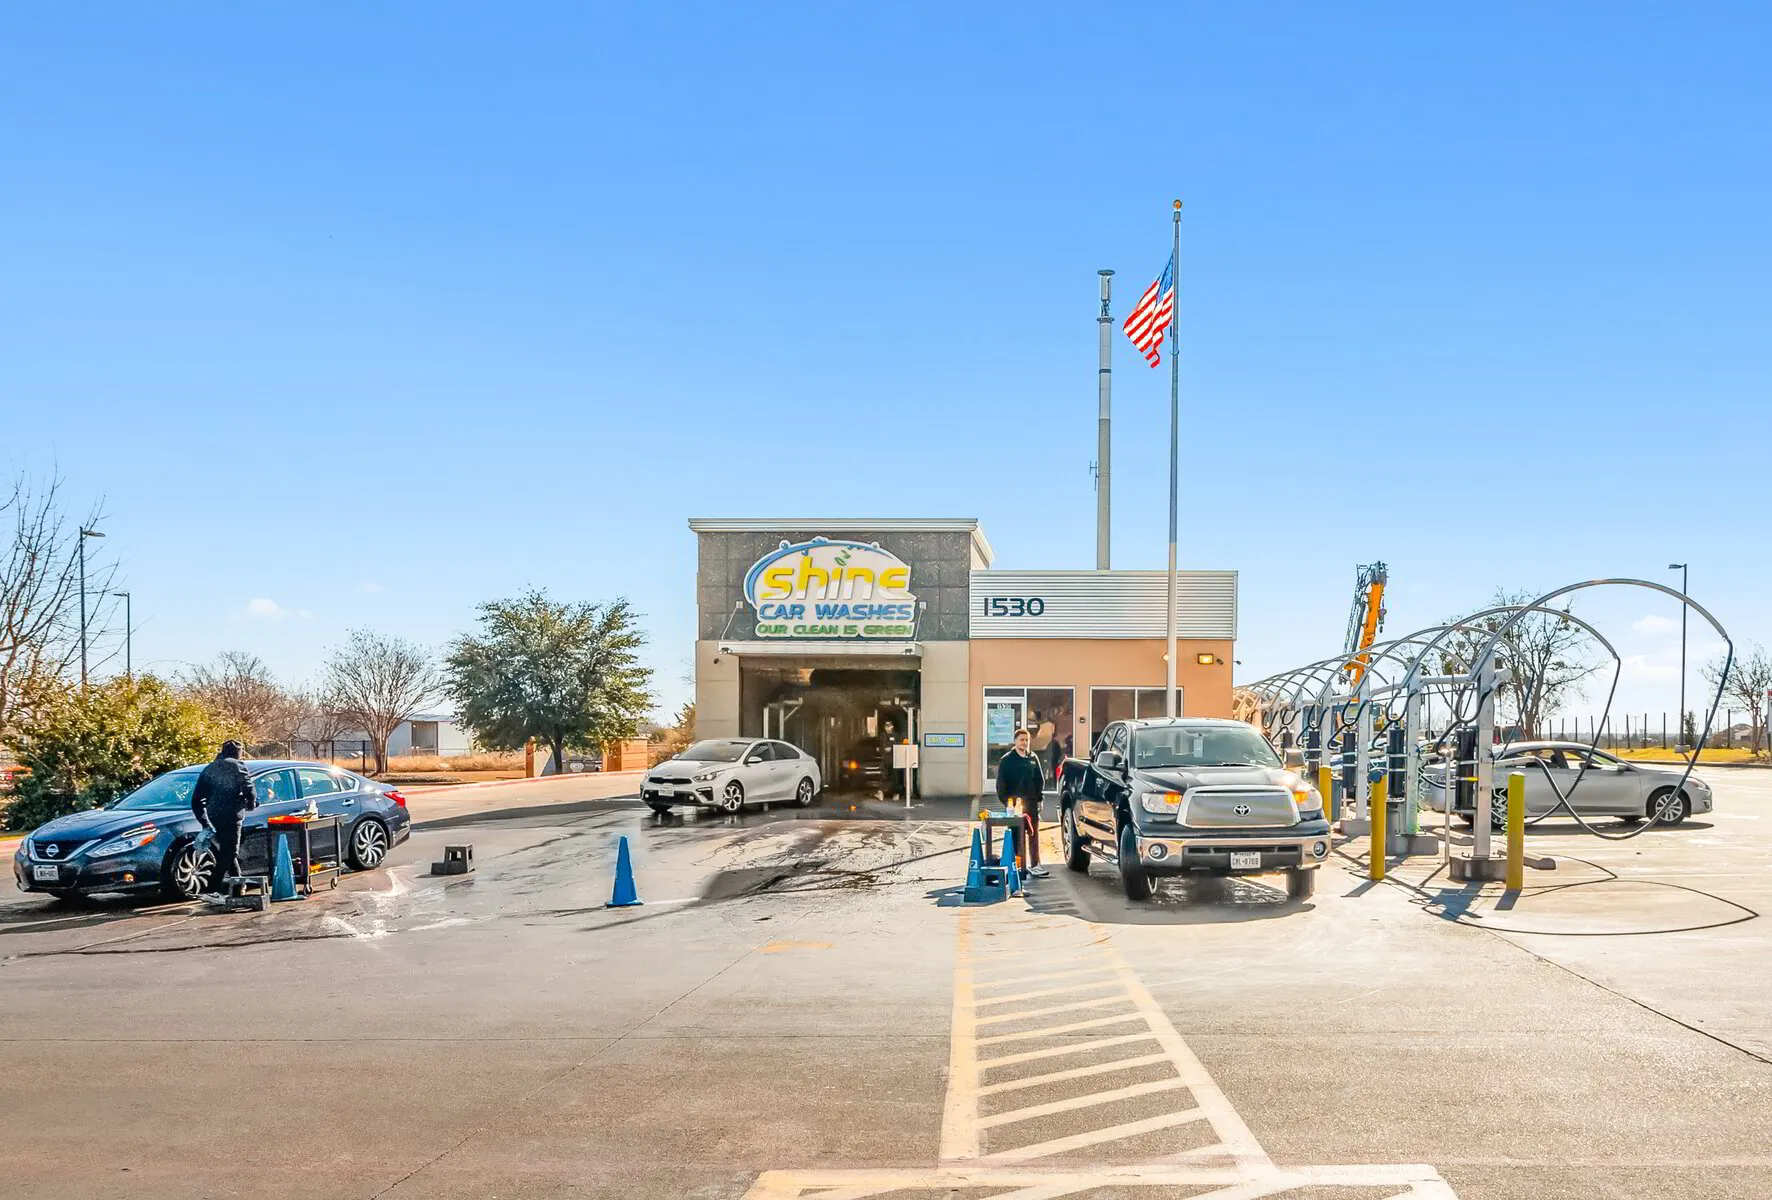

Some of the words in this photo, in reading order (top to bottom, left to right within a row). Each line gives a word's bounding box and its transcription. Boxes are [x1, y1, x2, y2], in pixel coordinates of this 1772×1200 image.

[760, 556, 912, 600] shine
[759, 603, 804, 620] CAR
[815, 603, 912, 620] WASHES
[984, 597, 1045, 616] 1530
[756, 624, 788, 635] OUR
[793, 624, 839, 635] CLEAN
[843, 624, 858, 635] IS
[863, 624, 912, 635] GREEN
